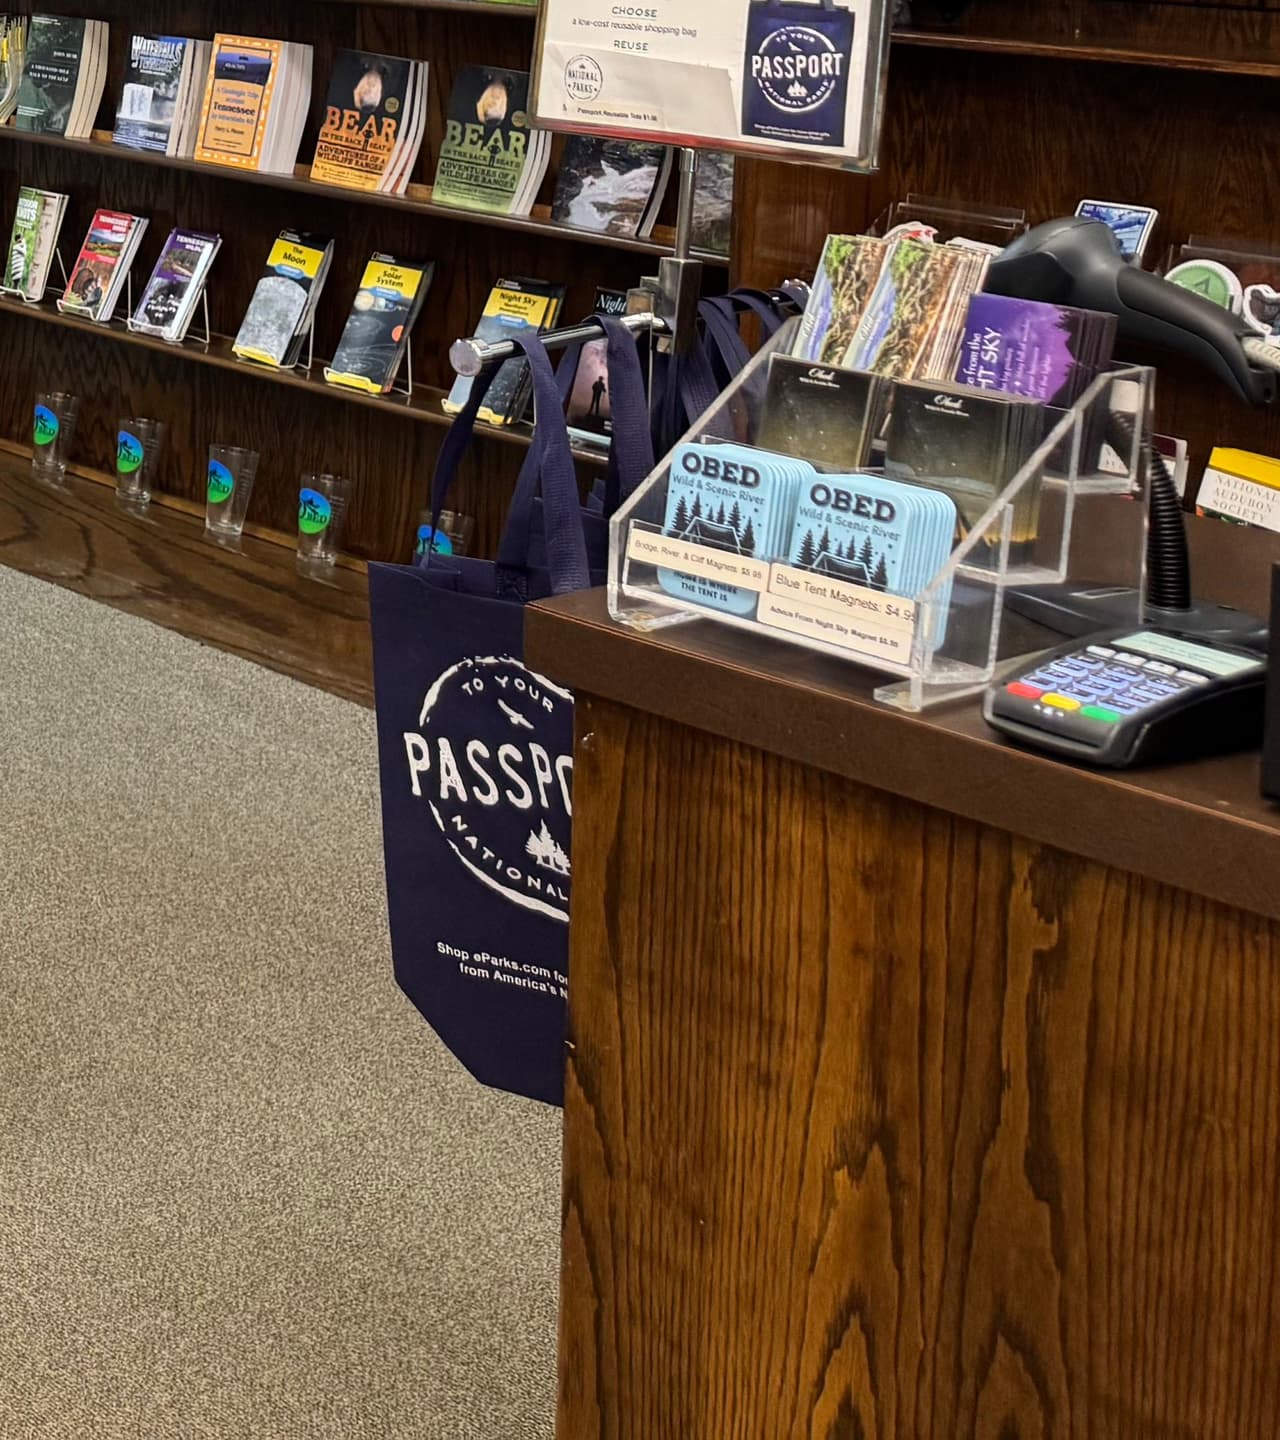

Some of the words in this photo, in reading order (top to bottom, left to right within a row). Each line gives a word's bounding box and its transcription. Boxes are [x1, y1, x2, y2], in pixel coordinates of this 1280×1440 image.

[612, 7, 658, 18] CHOOSE
[579, 18, 609, 28] low-cost
[611, 21, 642, 31] reusable
[644, 24, 679, 36] shopping
[682, 26, 697, 37] bag
[614, 40, 649, 51] REUSE
[752, 52, 844, 78] PASSPORT
[214, 101, 256, 116] Tennessee
[325, 106, 397, 138] BEAR
[446, 120, 527, 157] BEAR
[317, 152, 353, 166] WILDLIFE
[354, 158, 383, 171] RANGER
[318, 145, 368, 161] ADVENTURES
[370, 154, 378, 163] OF
[440, 161, 497, 179] ADVENTURES
[498, 171, 509, 180] OF
[440, 169, 480, 184] WILDLIFE
[482, 176, 515, 189] RANGER
[282, 254, 306, 266] Moon
[376, 276, 404, 288] System
[383, 270, 403, 280] Solar
[500, 292, 522, 302] Night
[522, 295, 537, 306] Sky
[596, 294, 627, 313] Night
[681, 452, 761, 490] OBED
[672, 473, 695, 488] Wild
[705, 480, 737, 498] Scenic
[739, 489, 765, 506] River
[809, 482, 896, 525] OBED
[1213, 488, 1273, 515] AUDUBON
[1213, 499, 1267, 524] SOCIETY
[799, 505, 821, 521] Wild
[834, 514, 871, 533] Scenic
[872, 524, 901, 541] River
[680, 583, 696, 595] THE
[697, 588, 718, 601] TENT
[719, 594, 728, 602] IS
[775, 573, 801, 591] Blue
[803, 580, 826, 598] Tent
[462, 677, 484, 696] TO
[494, 674, 554, 713] YOUR
[451, 814, 569, 902] NATIONAL
[436, 941, 469, 962] Shop
[473, 951, 551, 979] eParks.com
[459, 962, 490, 982] from
[493, 969, 557, 997] America's
